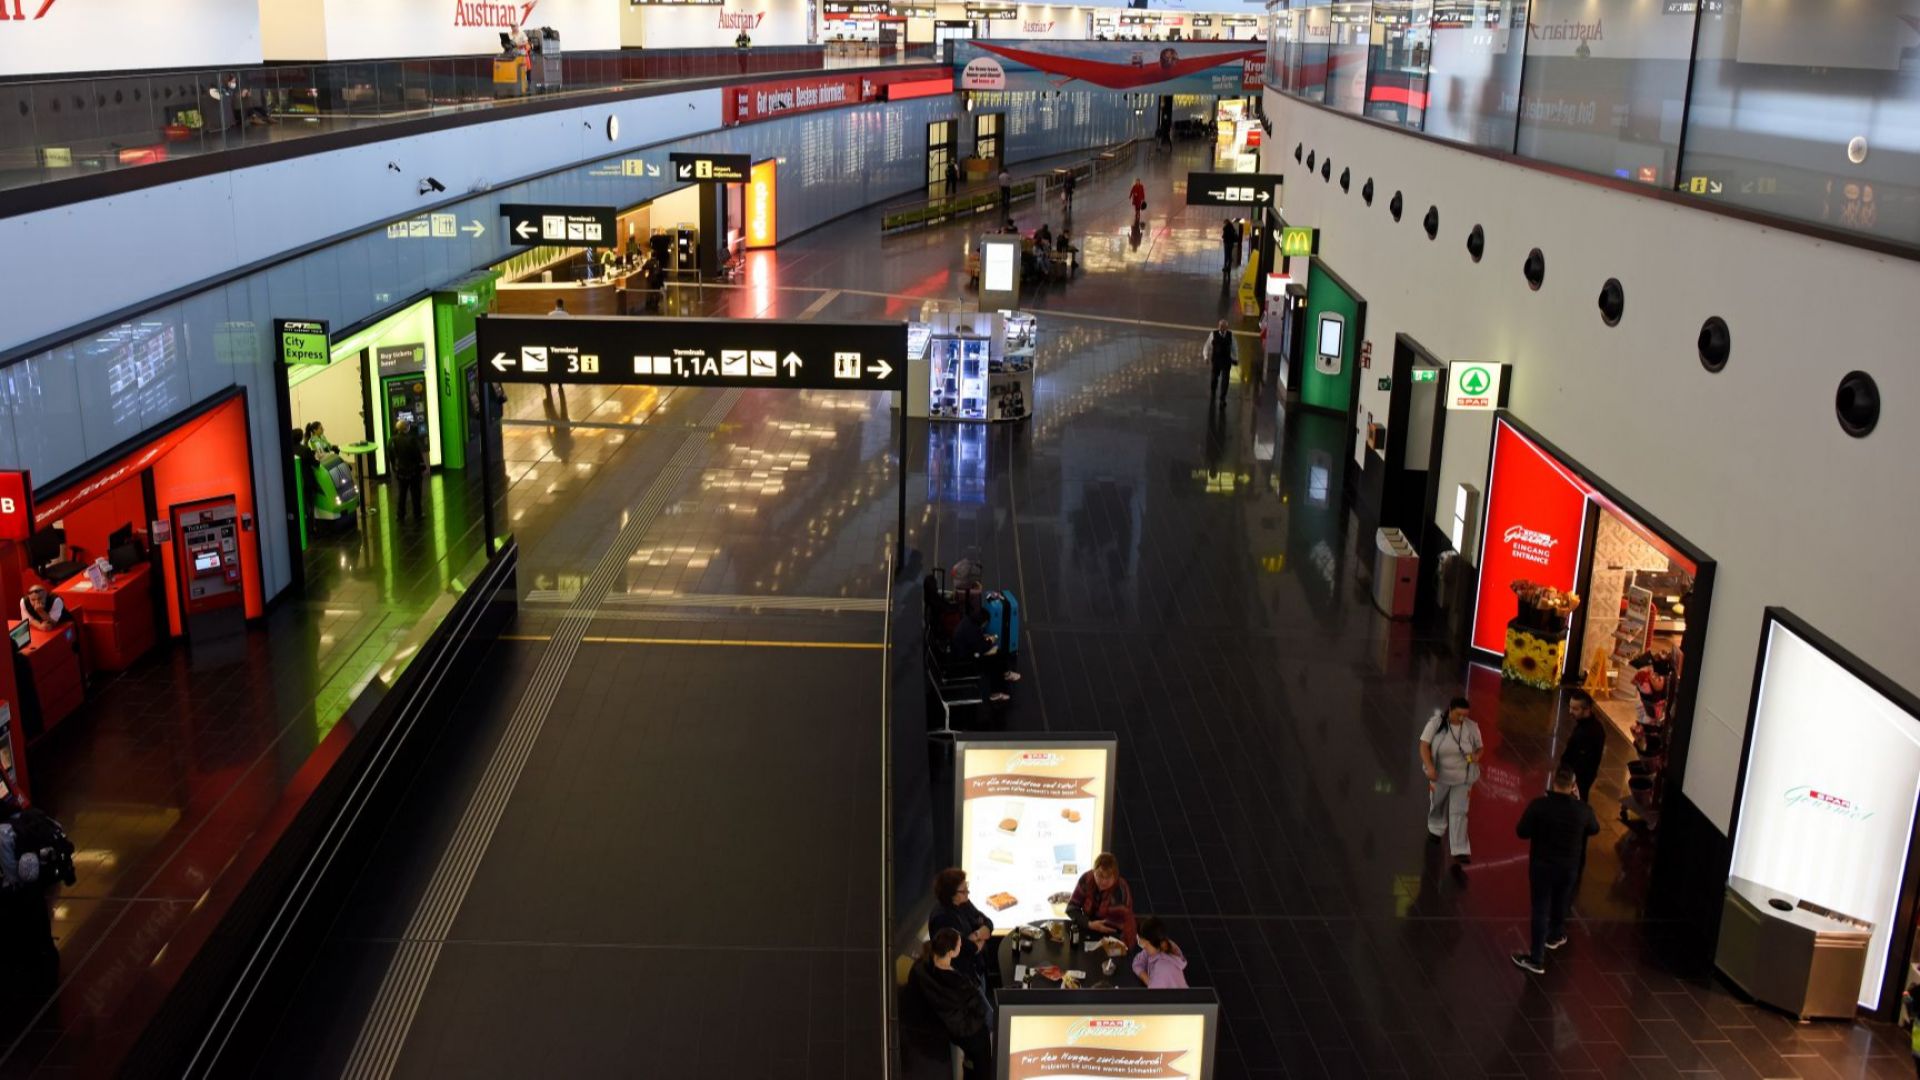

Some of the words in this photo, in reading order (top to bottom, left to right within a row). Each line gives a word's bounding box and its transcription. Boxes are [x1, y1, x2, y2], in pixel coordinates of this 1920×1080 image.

[454, 0, 516, 27] Austrian
[719, 8, 754, 29] Austrian
[1023, 20, 1047, 33] Austrian
[757, 91, 767, 114] Gut
[796, 85, 818, 108] Bestens
[819, 82, 846, 104] informiert.
[285, 336, 305, 349] City
[550, 346, 579, 354] Terminal
[286, 348, 323, 360] Express
[380, 352, 392, 361] Buy
[393, 350, 413, 358] tickets
[673, 348, 705, 356] Terminals
[567, 354, 580, 373] 3
[673, 357, 720, 378] 1,1A
[1457, 398, 1488, 406] SPAR
[1512, 549, 1549, 565] ENTRANCE
[1513, 542, 1550, 558] EINGANG
[1818, 792, 1850, 809] SPAR
[1022, 1056, 1039, 1065] Für
[1041, 1052, 1057, 1062] den
[1061, 1052, 1095, 1063] Hunger
[1096, 1053, 1163, 1066] zwischendurch!
